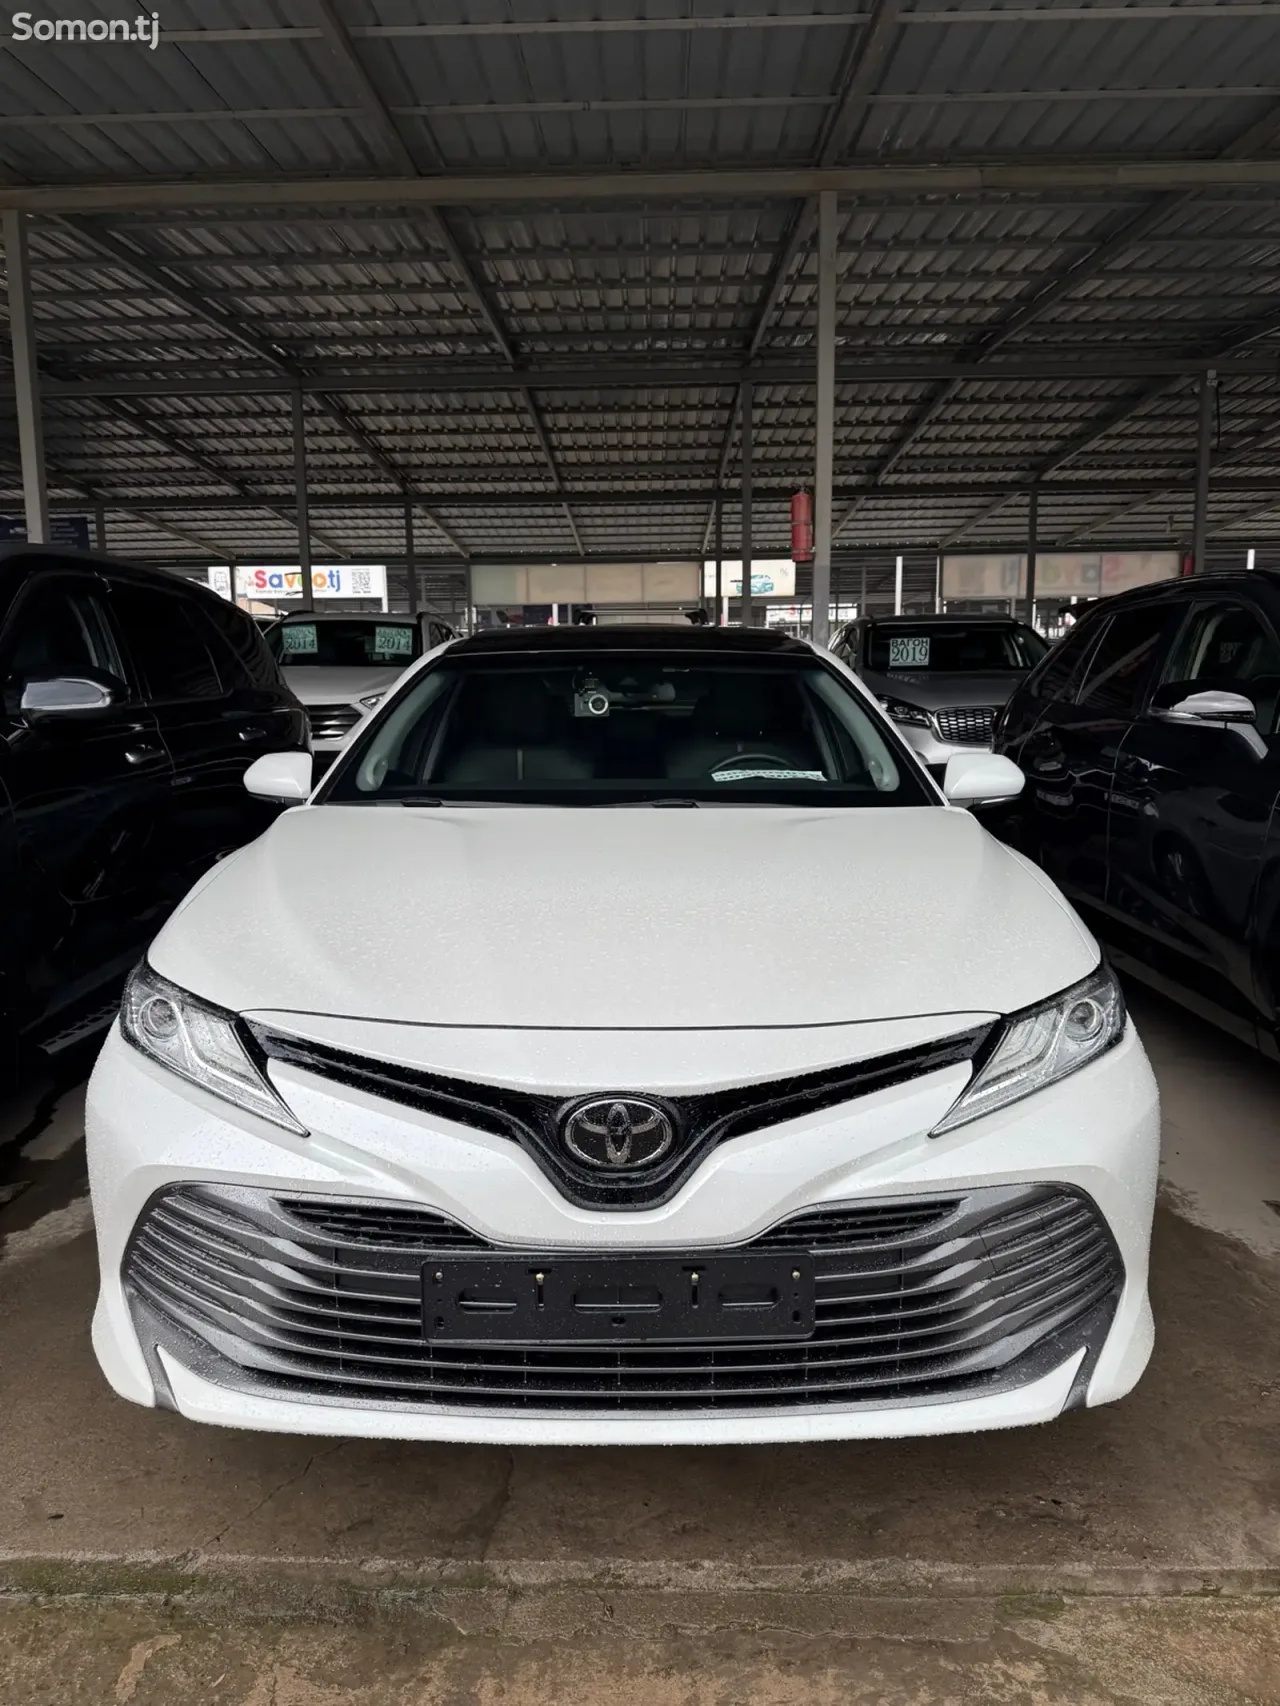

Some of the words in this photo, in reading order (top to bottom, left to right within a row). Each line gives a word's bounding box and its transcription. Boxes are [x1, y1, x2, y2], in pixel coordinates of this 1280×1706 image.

[254, 569, 341, 592] Savo.tj
[378, 636, 411, 651] 2014
[892, 638, 928, 647] ВАГОН
[891, 646, 928, 662] 2019
